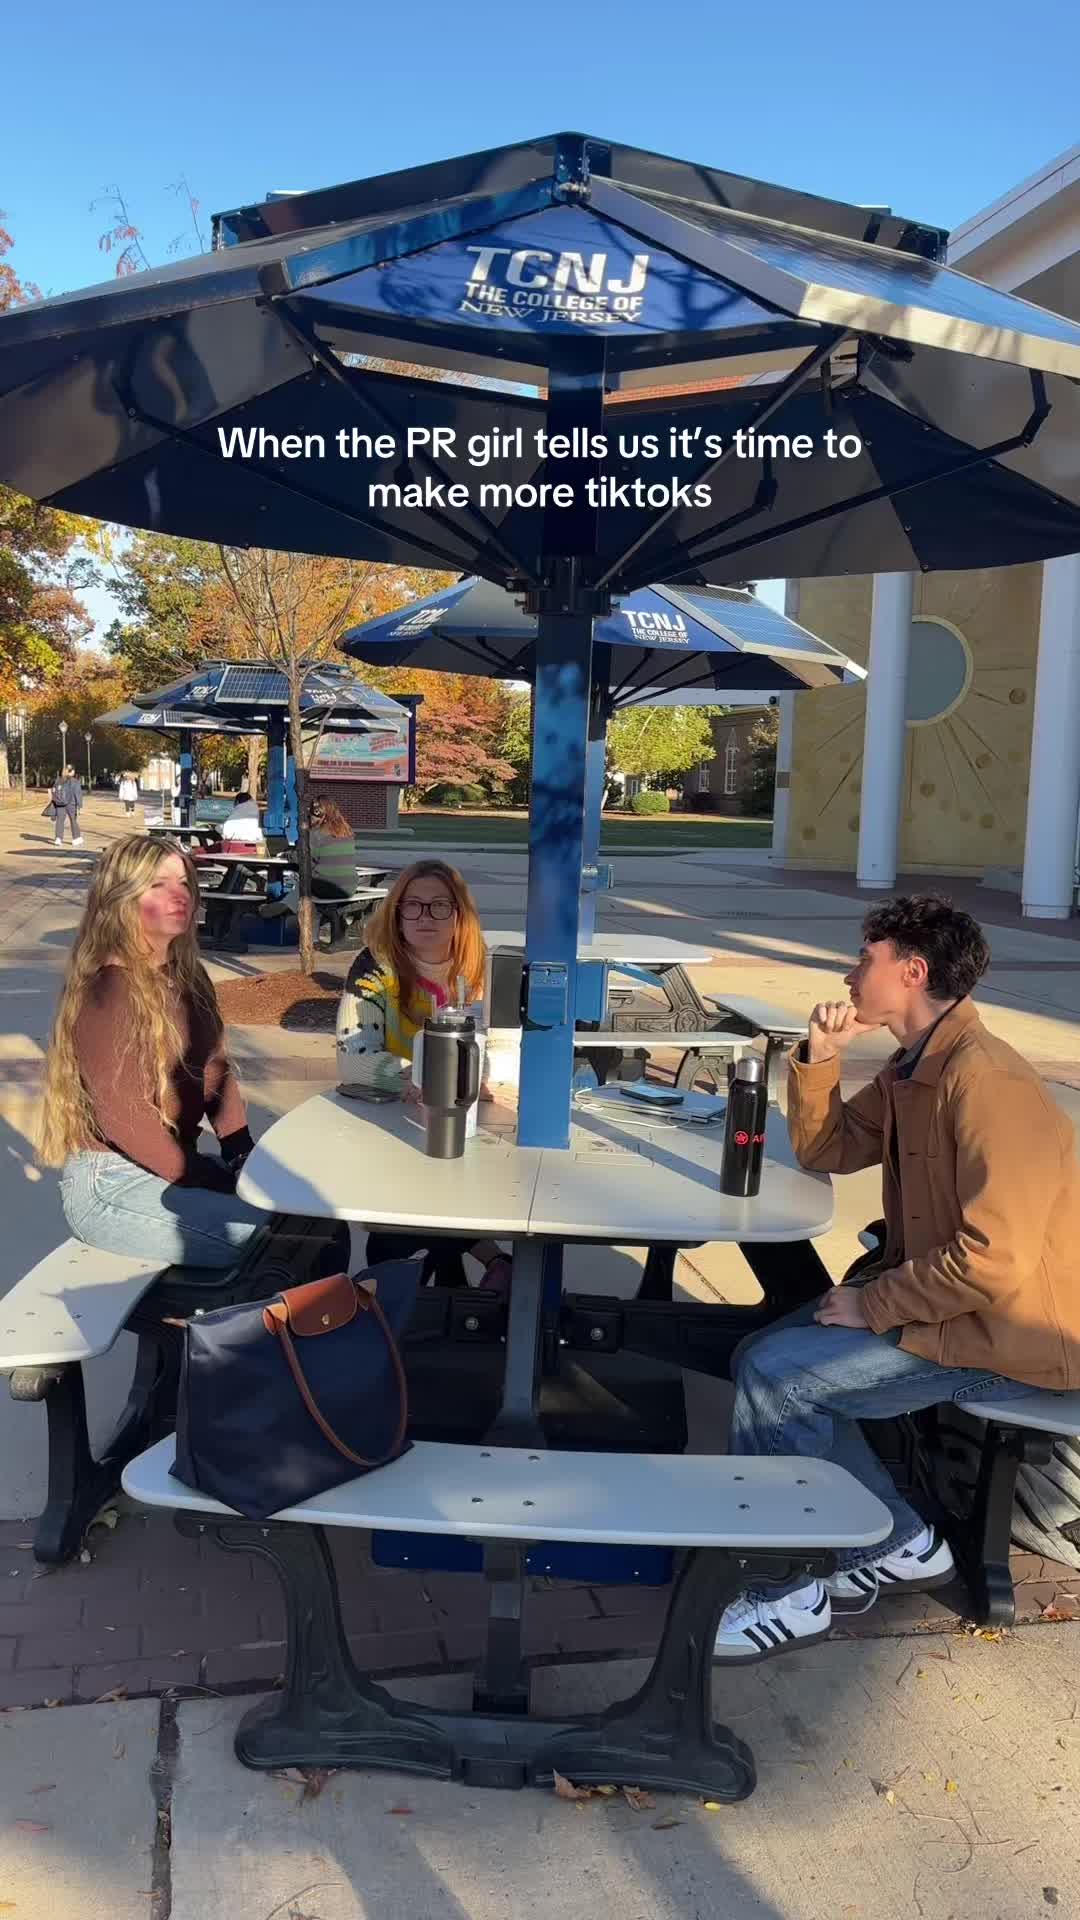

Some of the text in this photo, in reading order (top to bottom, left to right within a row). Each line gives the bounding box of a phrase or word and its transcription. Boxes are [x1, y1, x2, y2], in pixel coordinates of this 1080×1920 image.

[466, 245, 649, 294] TCNJ
[464, 281, 643, 311] THE COLLEGE OF
[458, 300, 642, 323] NEW JERSEY
[621, 610, 686, 631] TCNJ
